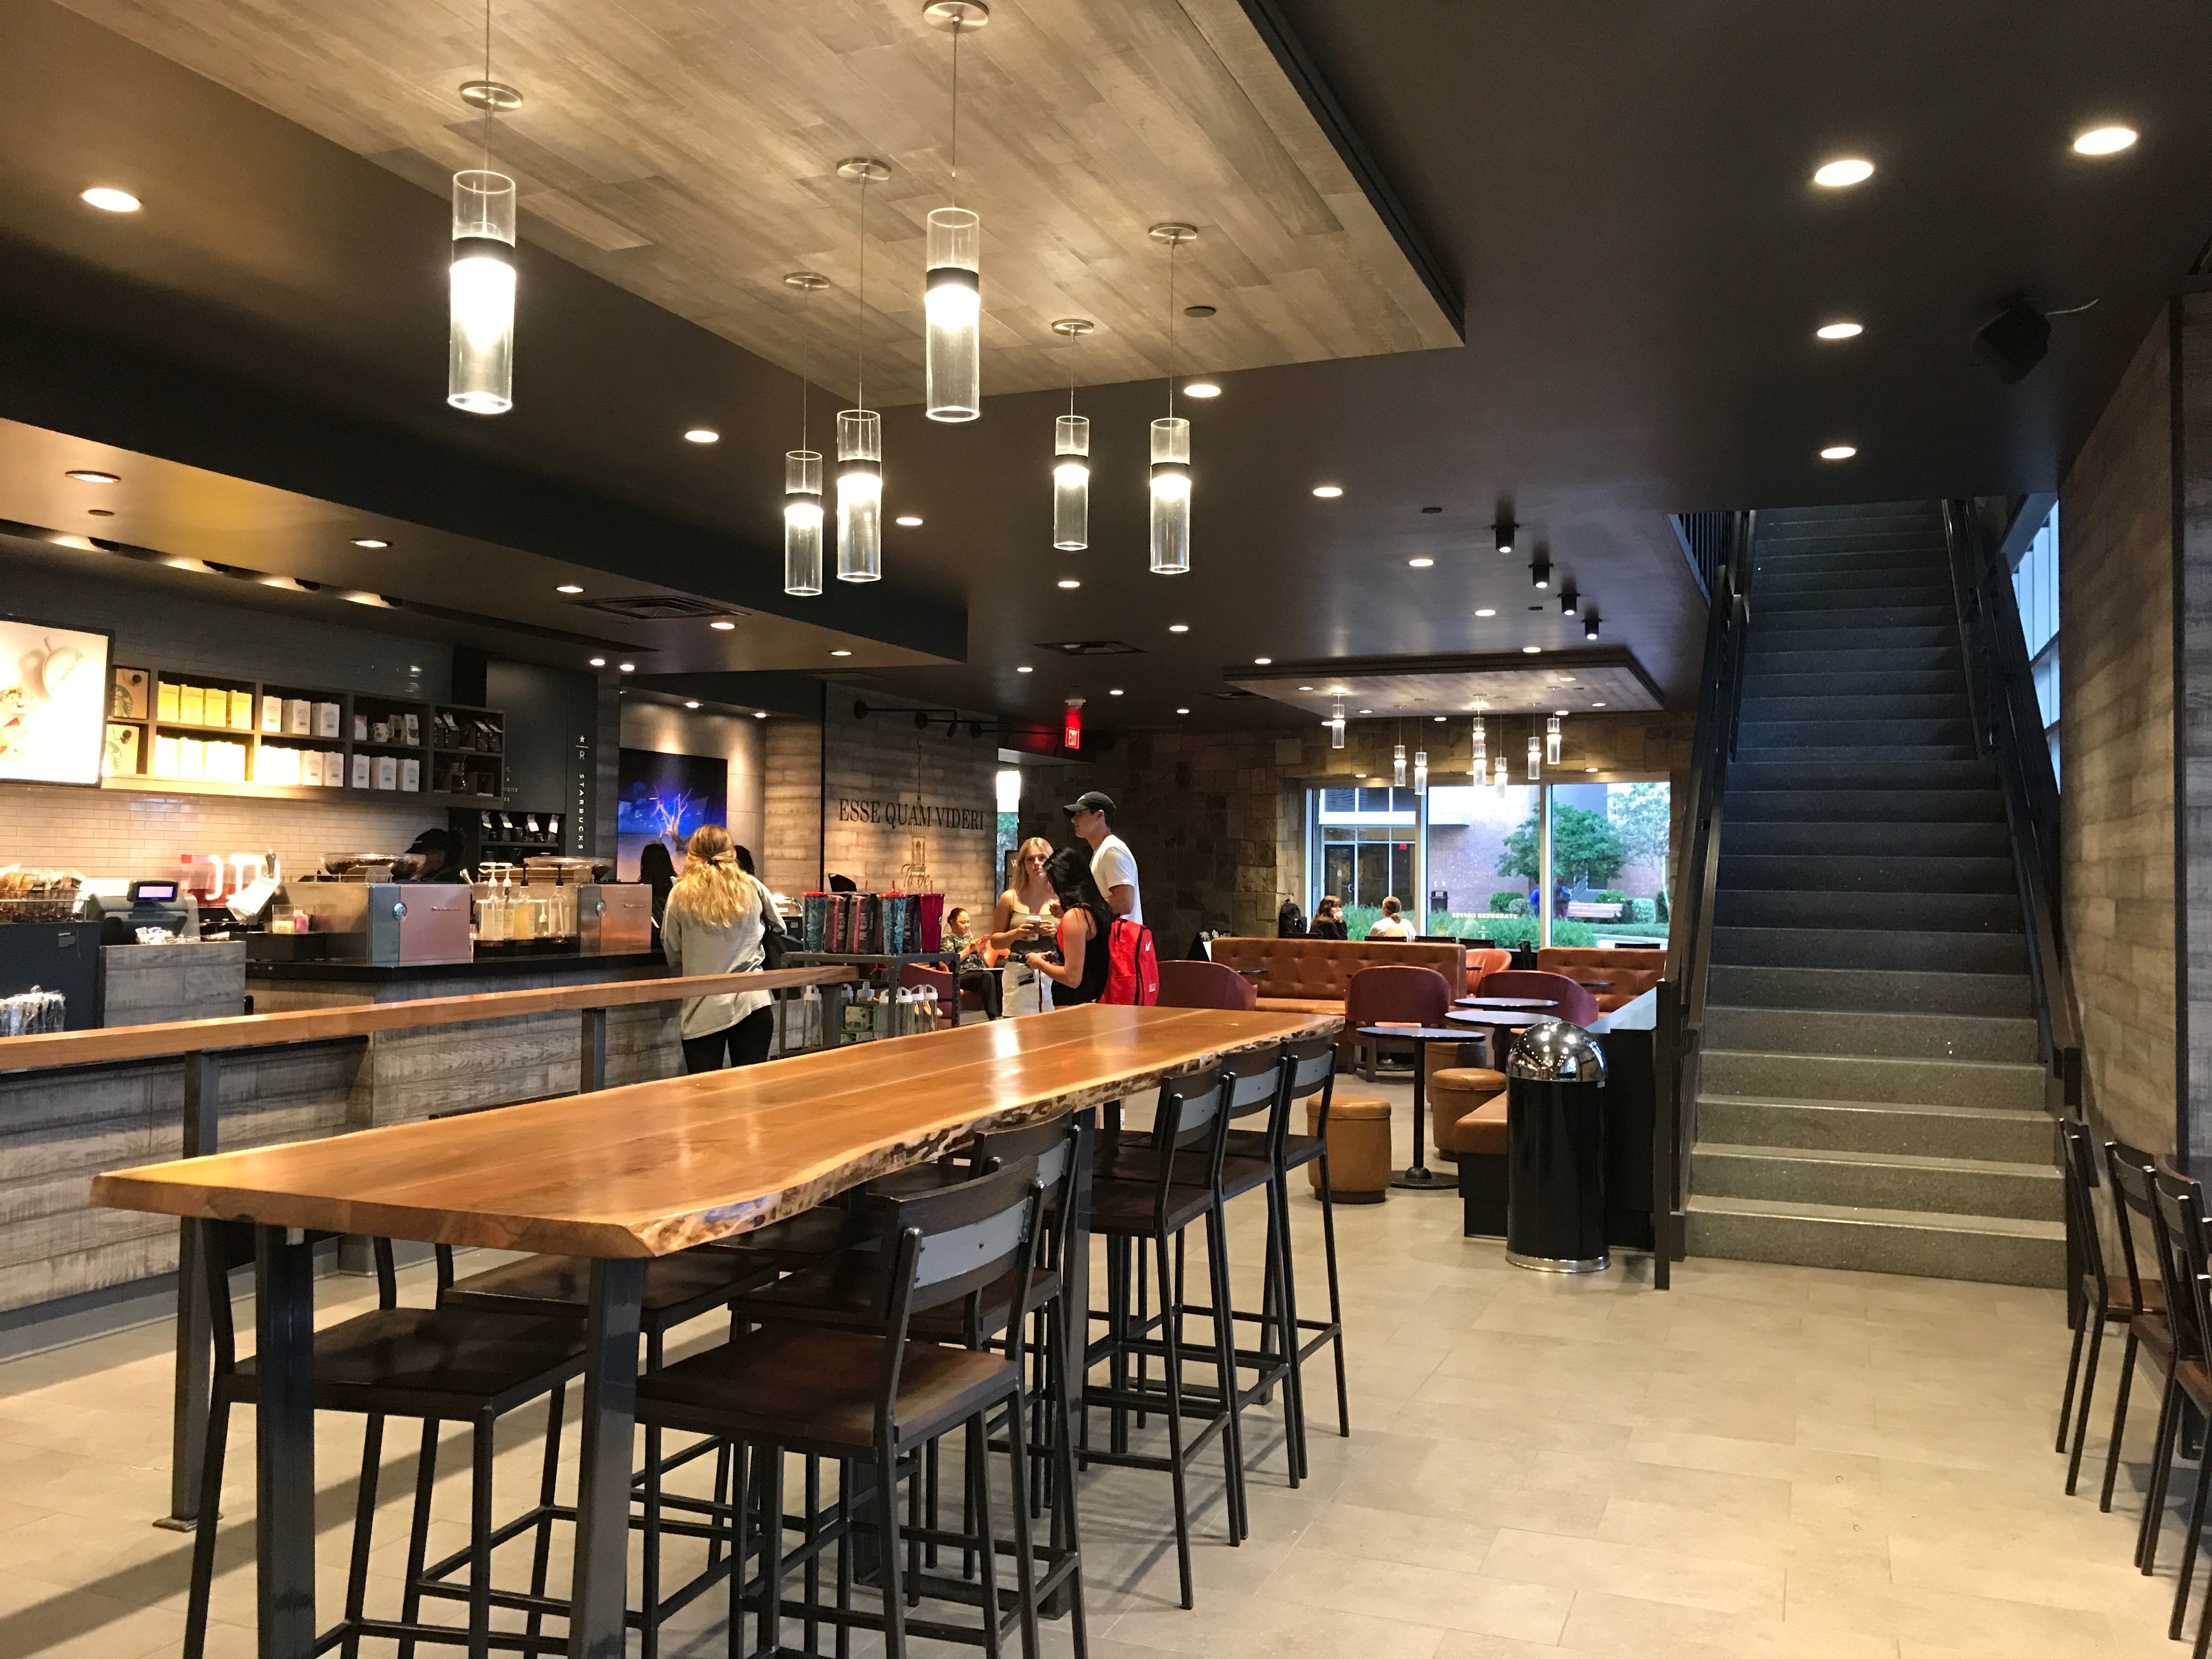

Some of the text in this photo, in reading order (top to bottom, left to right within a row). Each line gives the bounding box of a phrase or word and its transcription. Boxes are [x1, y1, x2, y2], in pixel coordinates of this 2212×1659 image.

[838, 798, 985, 830] ESSE QUAM VIDERI
